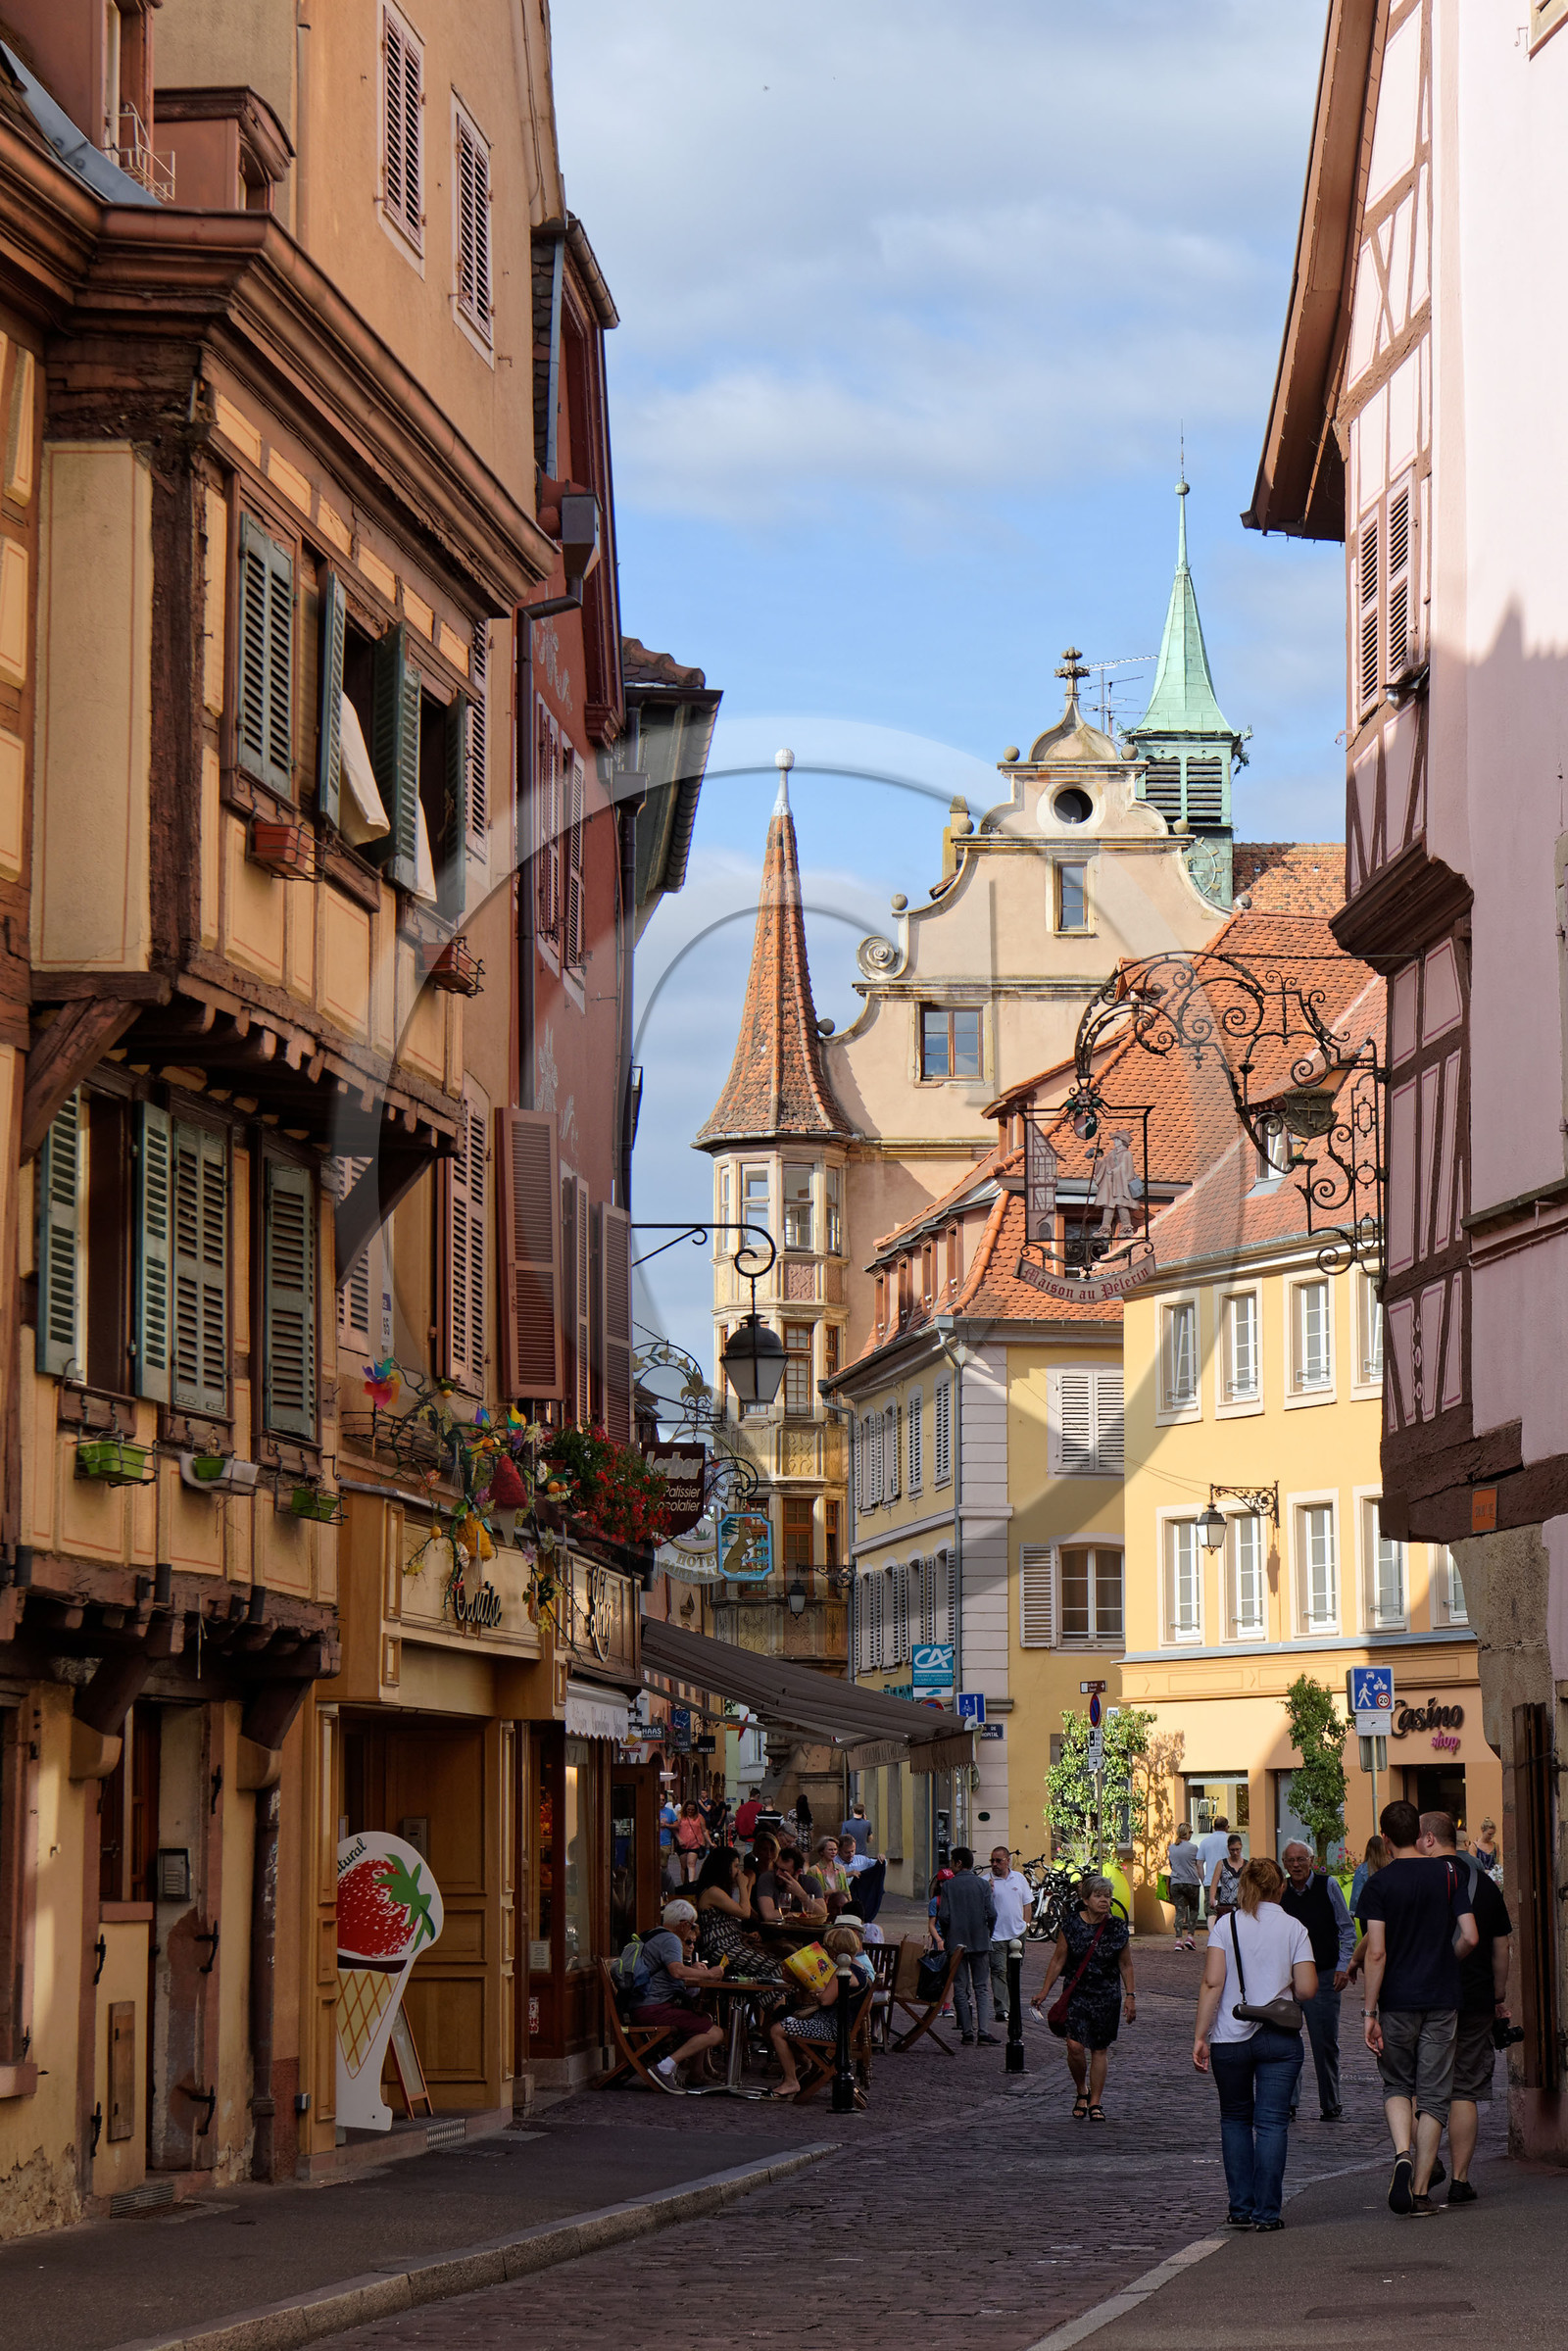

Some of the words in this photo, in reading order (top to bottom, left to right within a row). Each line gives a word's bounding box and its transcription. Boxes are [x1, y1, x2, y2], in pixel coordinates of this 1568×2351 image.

[1021, 1267, 1074, 1298] Maison
[1079, 1289, 1096, 1299] au
[1101, 1266, 1149, 1298] Pélerin
[676, 1552, 716, 1568] HOTE
[1379, 1696, 1389, 1705] 20
[1392, 1696, 1463, 1739] Casino
[1431, 1730, 1458, 1752] shop
